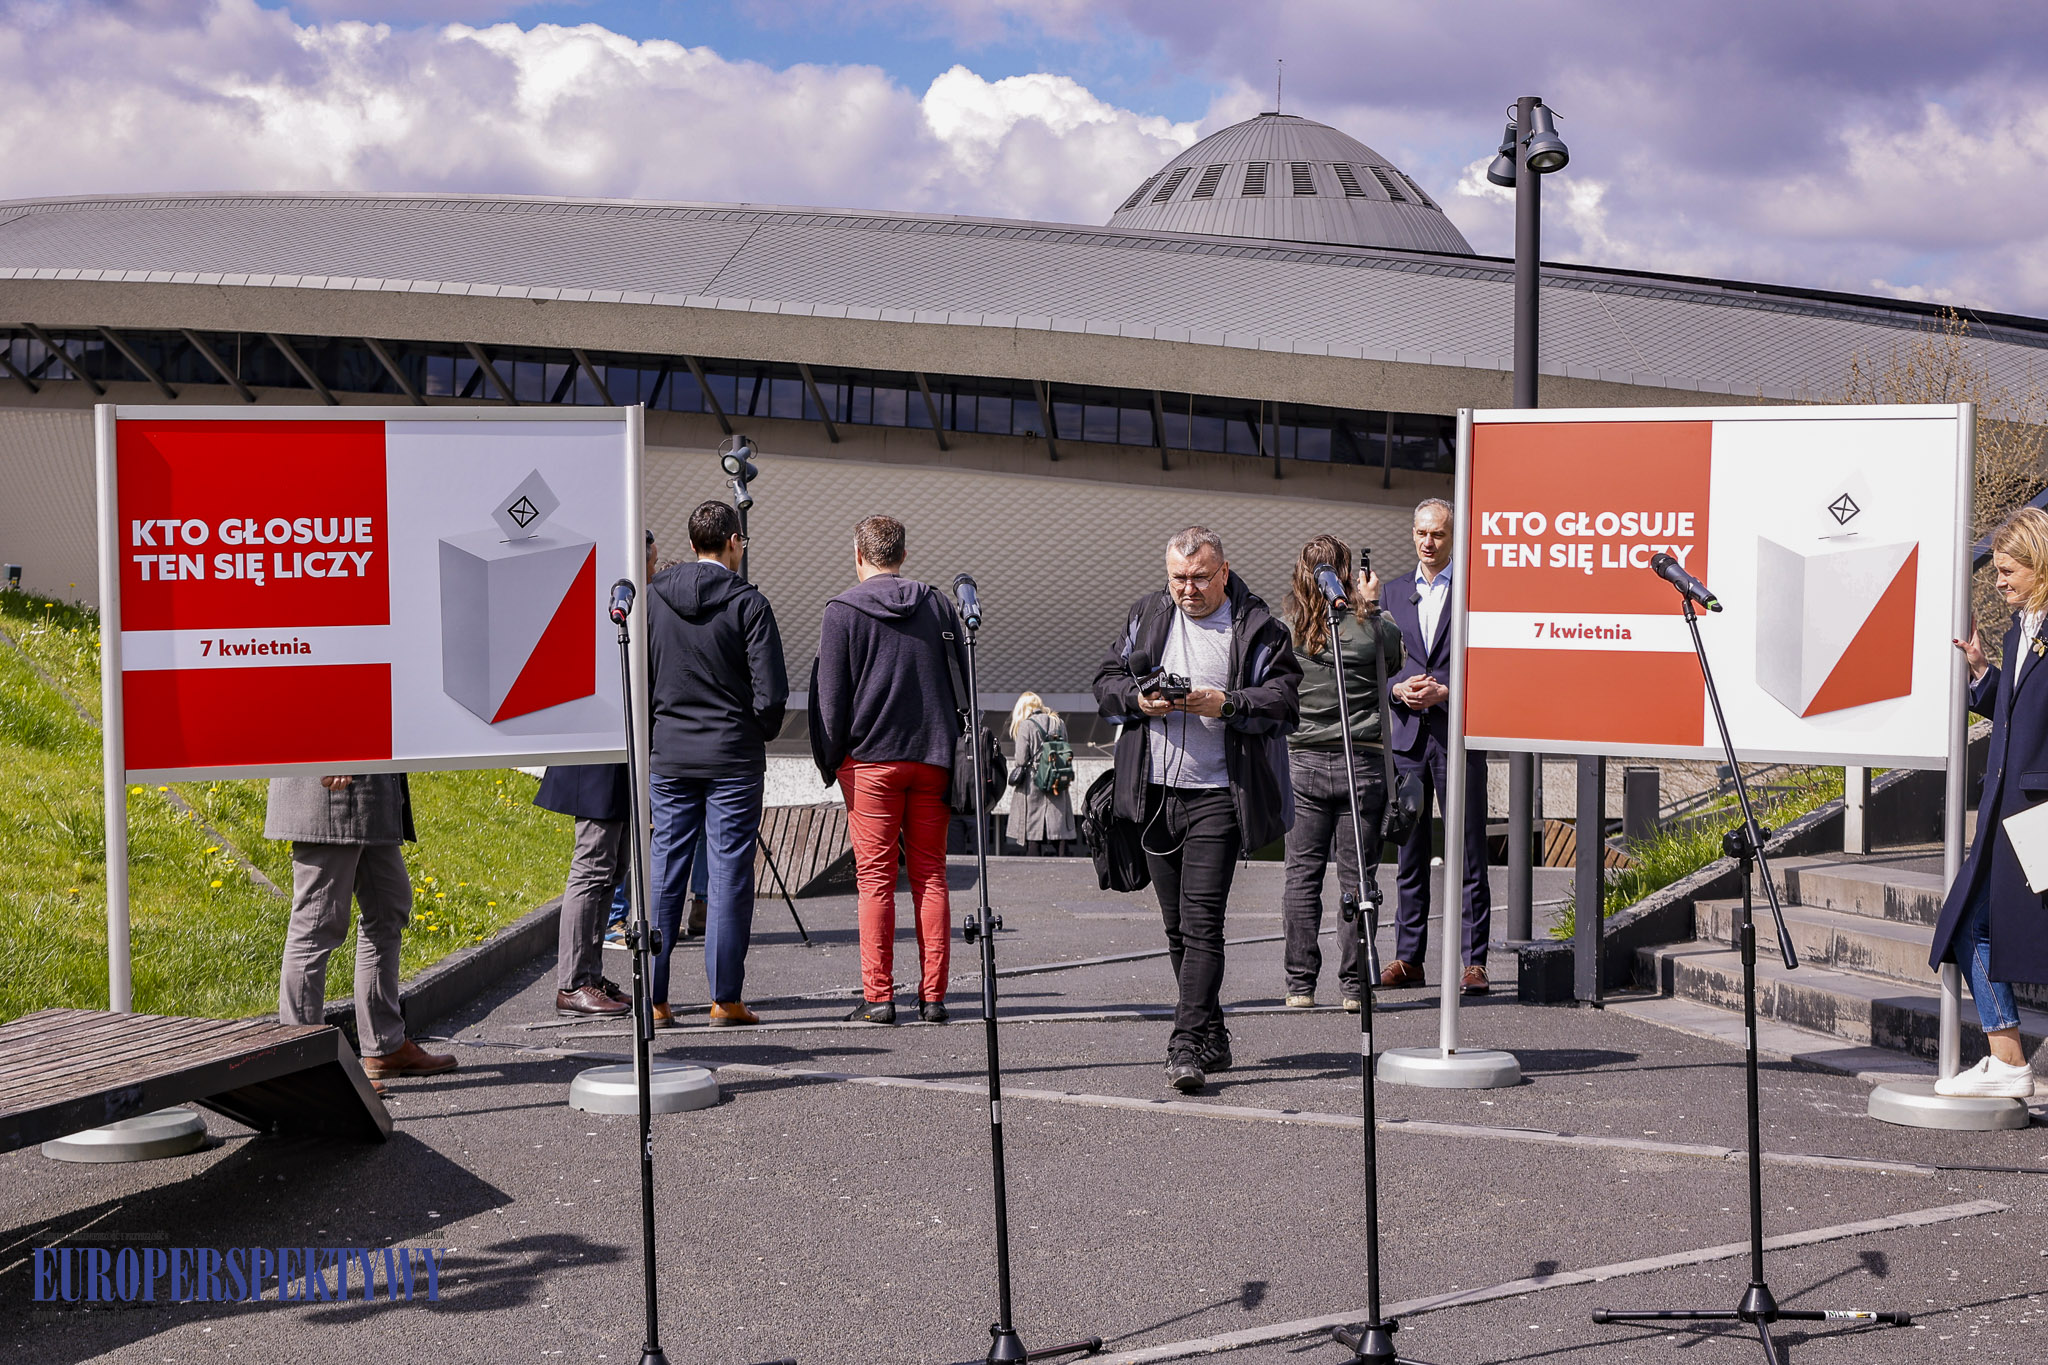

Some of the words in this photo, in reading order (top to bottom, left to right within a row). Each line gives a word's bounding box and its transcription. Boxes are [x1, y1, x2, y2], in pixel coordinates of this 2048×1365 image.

[132, 518, 210, 547] KTO
[218, 517, 374, 546] GŁOSUJE
[1481, 511, 1548, 537] KTO
[1554, 511, 1695, 537] GŁOSUJE
[133, 553, 205, 581] TEN
[213, 552, 266, 587] SIĘ
[273, 551, 374, 579] LICZY
[1481, 543, 1542, 568] TEN
[1549, 543, 1594, 576] SIĘ
[1534, 622, 1545, 639] 7
[1550, 622, 1632, 640] kwietnia
[200, 639, 213, 657] 7
[218, 637, 312, 657] kwietnia
